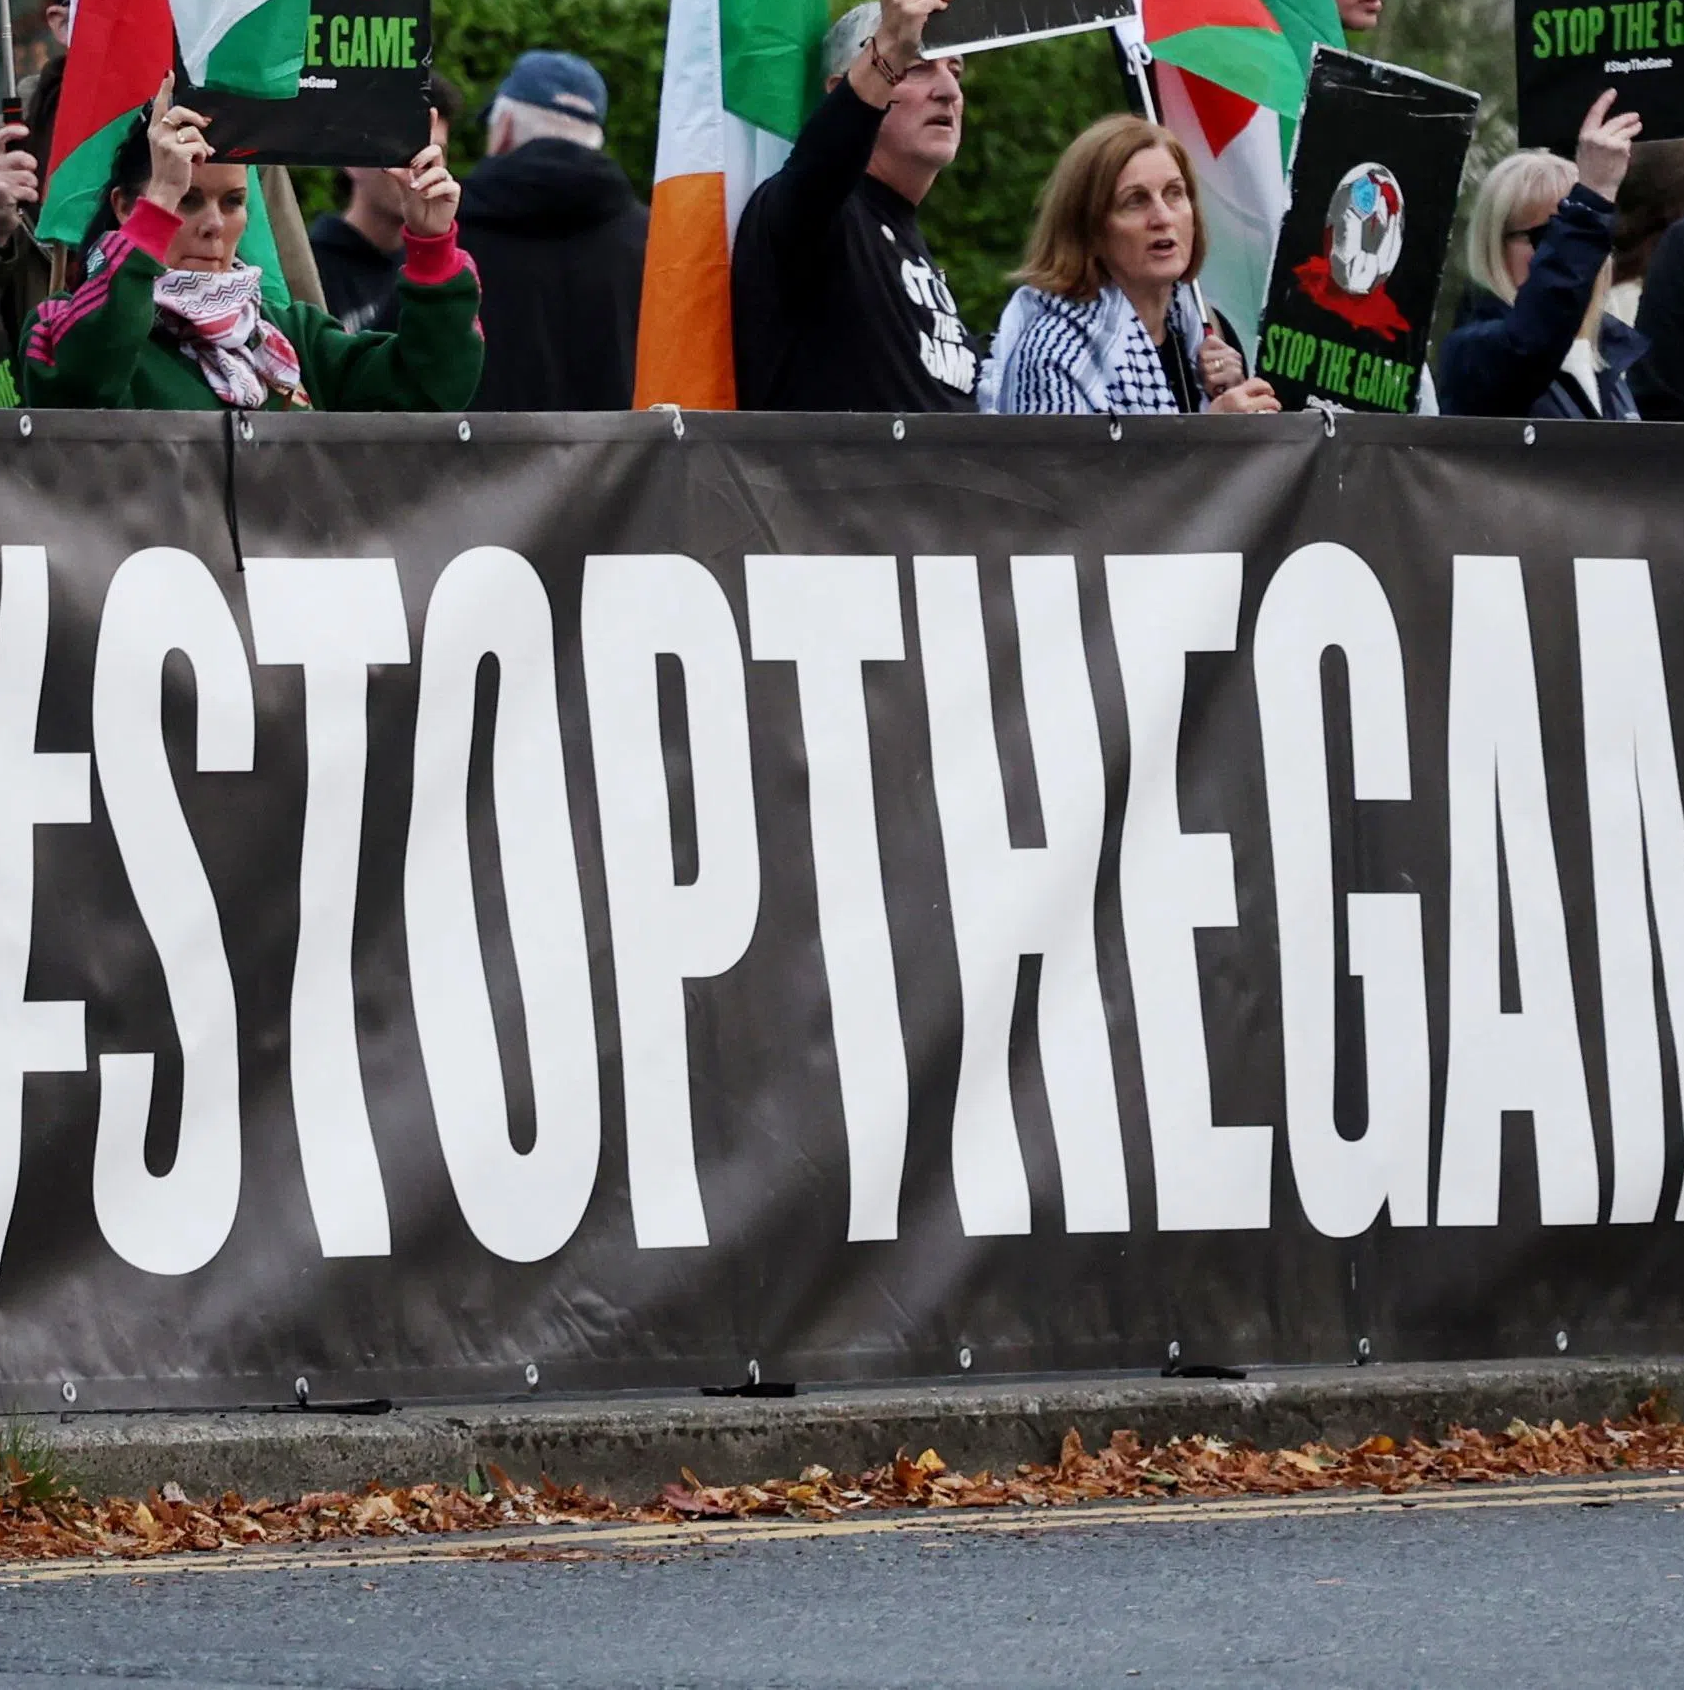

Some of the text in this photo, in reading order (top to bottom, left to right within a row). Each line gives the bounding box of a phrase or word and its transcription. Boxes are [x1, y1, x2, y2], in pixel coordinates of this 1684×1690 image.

[329, 14, 418, 69] GAME
[1531, 6, 1605, 59] STOP
[1610, 0, 1661, 52] THE
[1603, 57, 1673, 74] #StopTheGame
[932, 310, 968, 344] THE
[918, 329, 978, 396] GAME
[1261, 323, 1416, 415] STOP THE GAME
